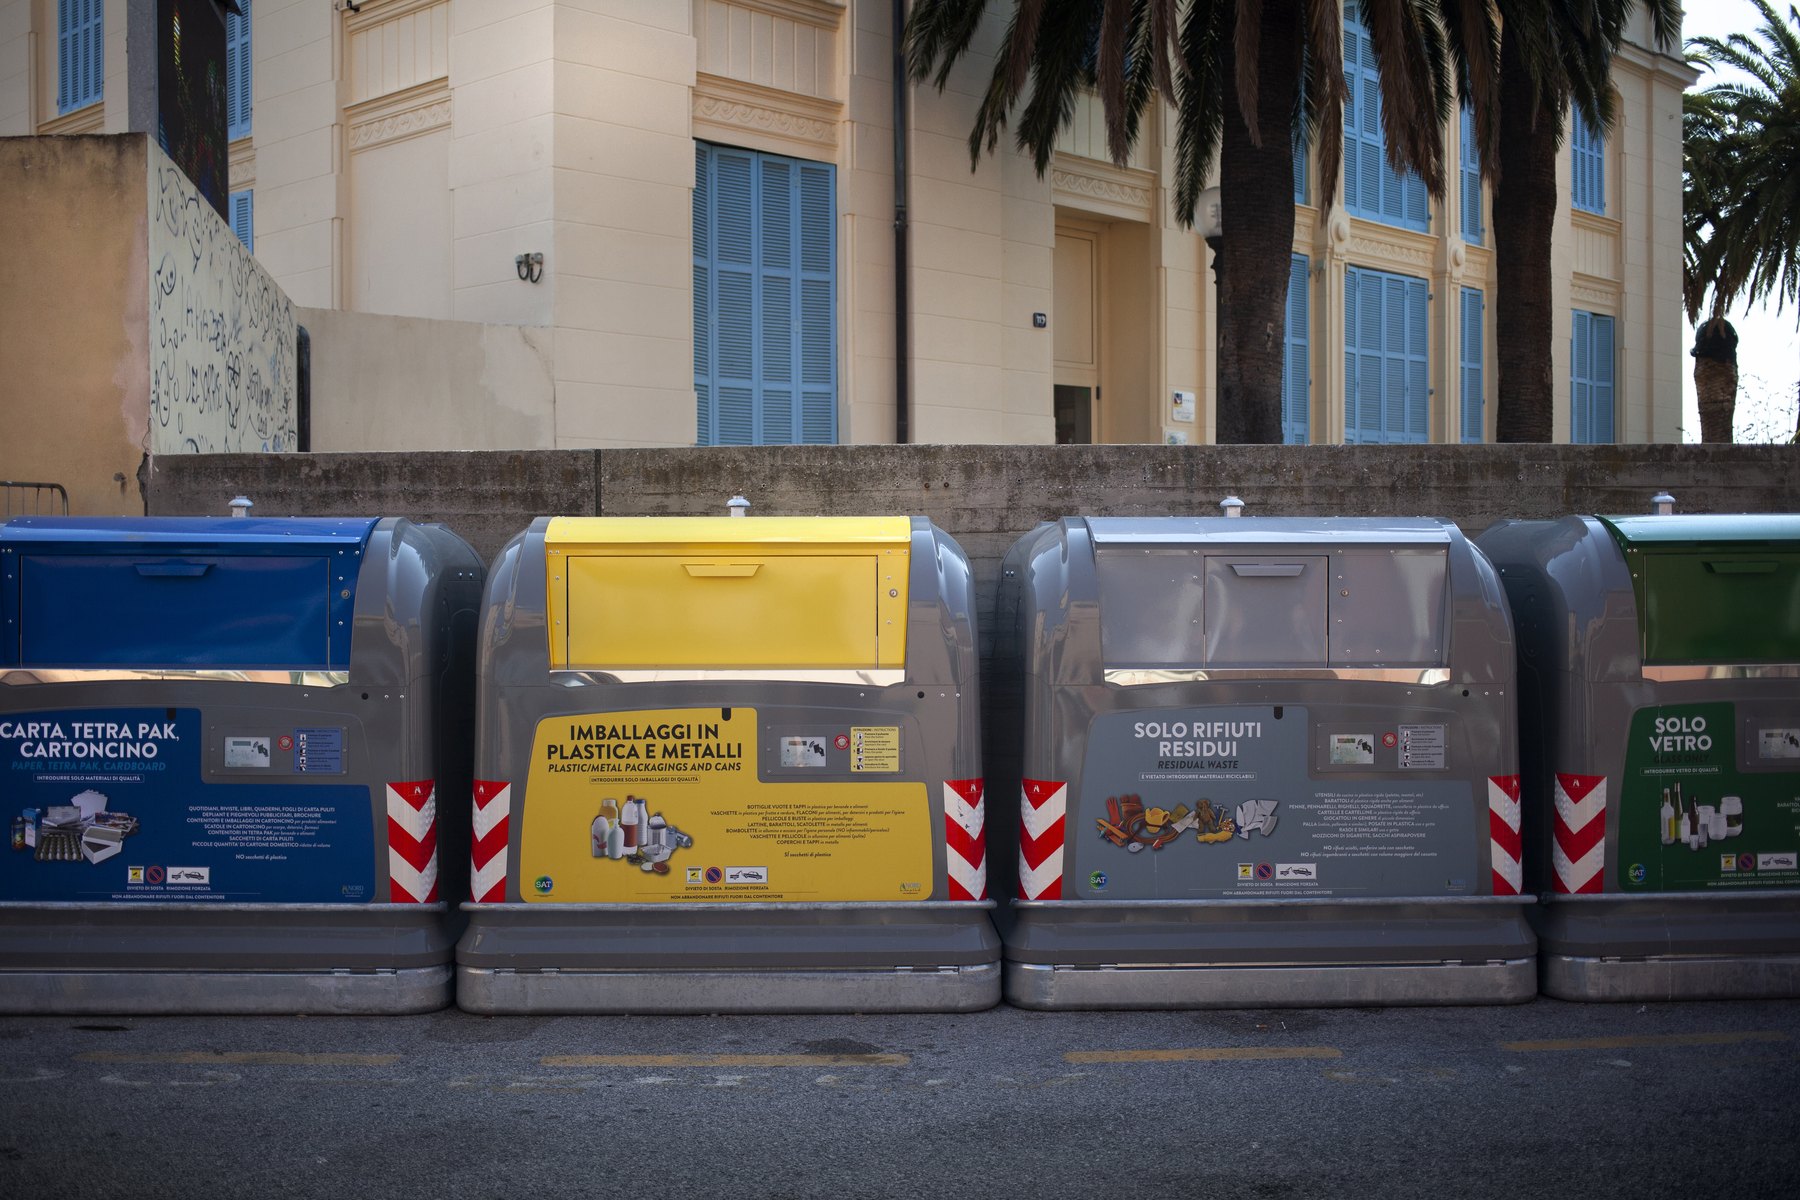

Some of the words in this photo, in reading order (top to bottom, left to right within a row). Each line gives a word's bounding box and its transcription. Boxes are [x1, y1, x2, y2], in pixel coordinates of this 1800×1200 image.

[0, 723, 68, 741] CARTA,
[72, 723, 133, 739] TETRA
[138, 723, 180, 741] PAK,
[570, 724, 691, 740] IMBALLAGGI
[698, 724, 719, 739] IN
[1134, 722, 1187, 738] SOLO
[1193, 722, 1261, 738] RIFIUTI
[1655, 717, 1706, 733] SOLO
[20, 742, 158, 758] CARTONCINO
[547, 744, 640, 760] PLASTICA
[646, 743, 656, 759] E
[662, 743, 742, 759] METALLI
[1159, 741, 1237, 757] RESIDUI
[1649, 735, 1712, 752] VETRO
[48, 761, 77, 771] TETRA
[103, 761, 166, 771] CARDBOARD
[1158, 760, 1204, 769] RESIDUAL
[1208, 760, 1239, 769] WASTE
[1654, 754, 1682, 763] GLASS
[1684, 754, 1710, 763] ONLY
[548, 763, 623, 773] PLASTIC/METAL
[625, 763, 688, 772] PACKAGINGS
[690, 763, 713, 771] AND
[715, 762, 741, 771] CANS
[1090, 876, 1106, 884] SAT
